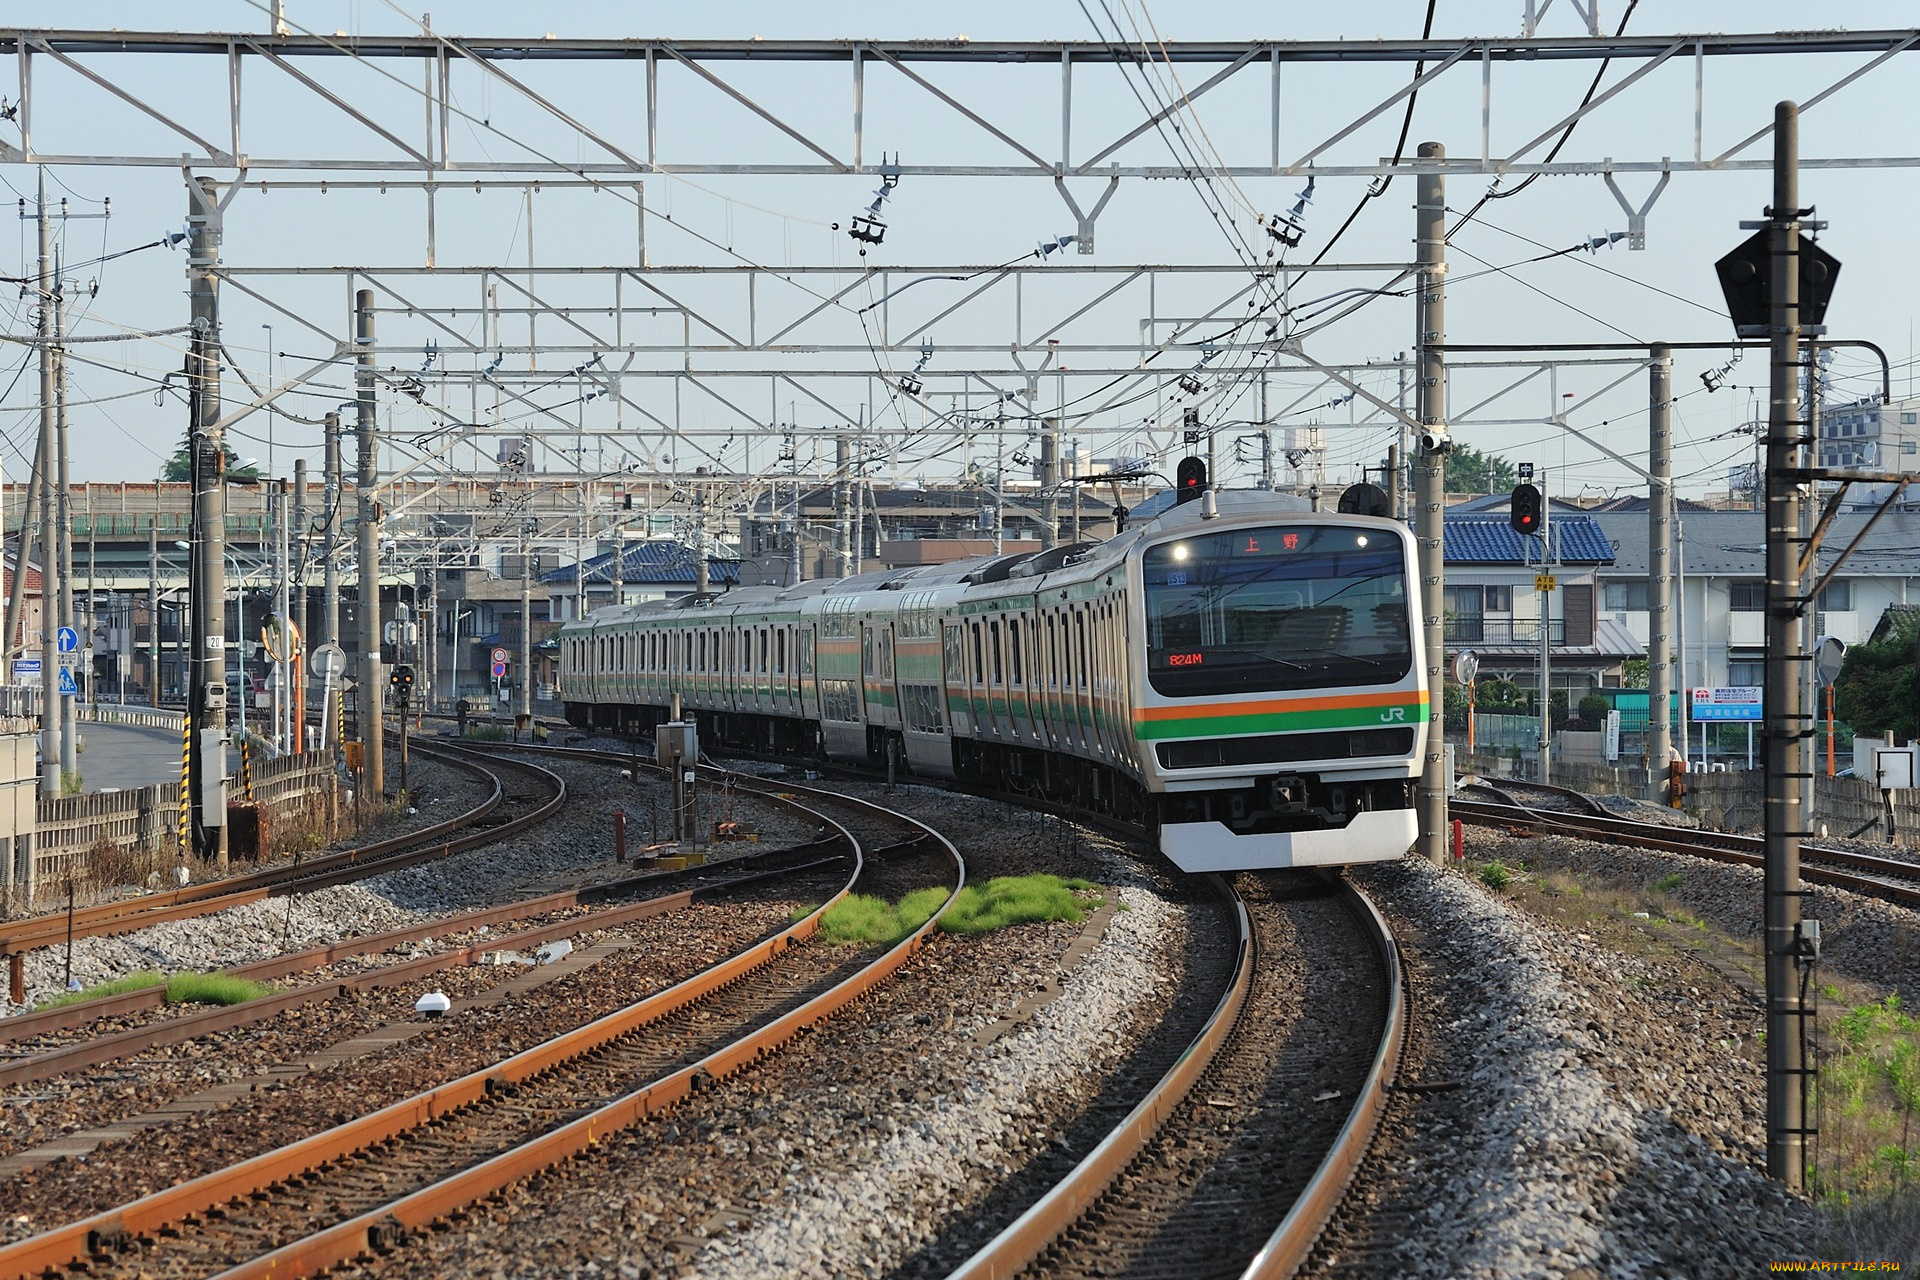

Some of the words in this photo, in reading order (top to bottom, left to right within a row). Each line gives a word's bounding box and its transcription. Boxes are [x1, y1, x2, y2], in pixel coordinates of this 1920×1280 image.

[1245, 533, 1298, 551] 上野
[211, 637, 220, 647] 20
[1170, 653, 1202, 665] 824M
[1381, 707, 1404, 721] JR
